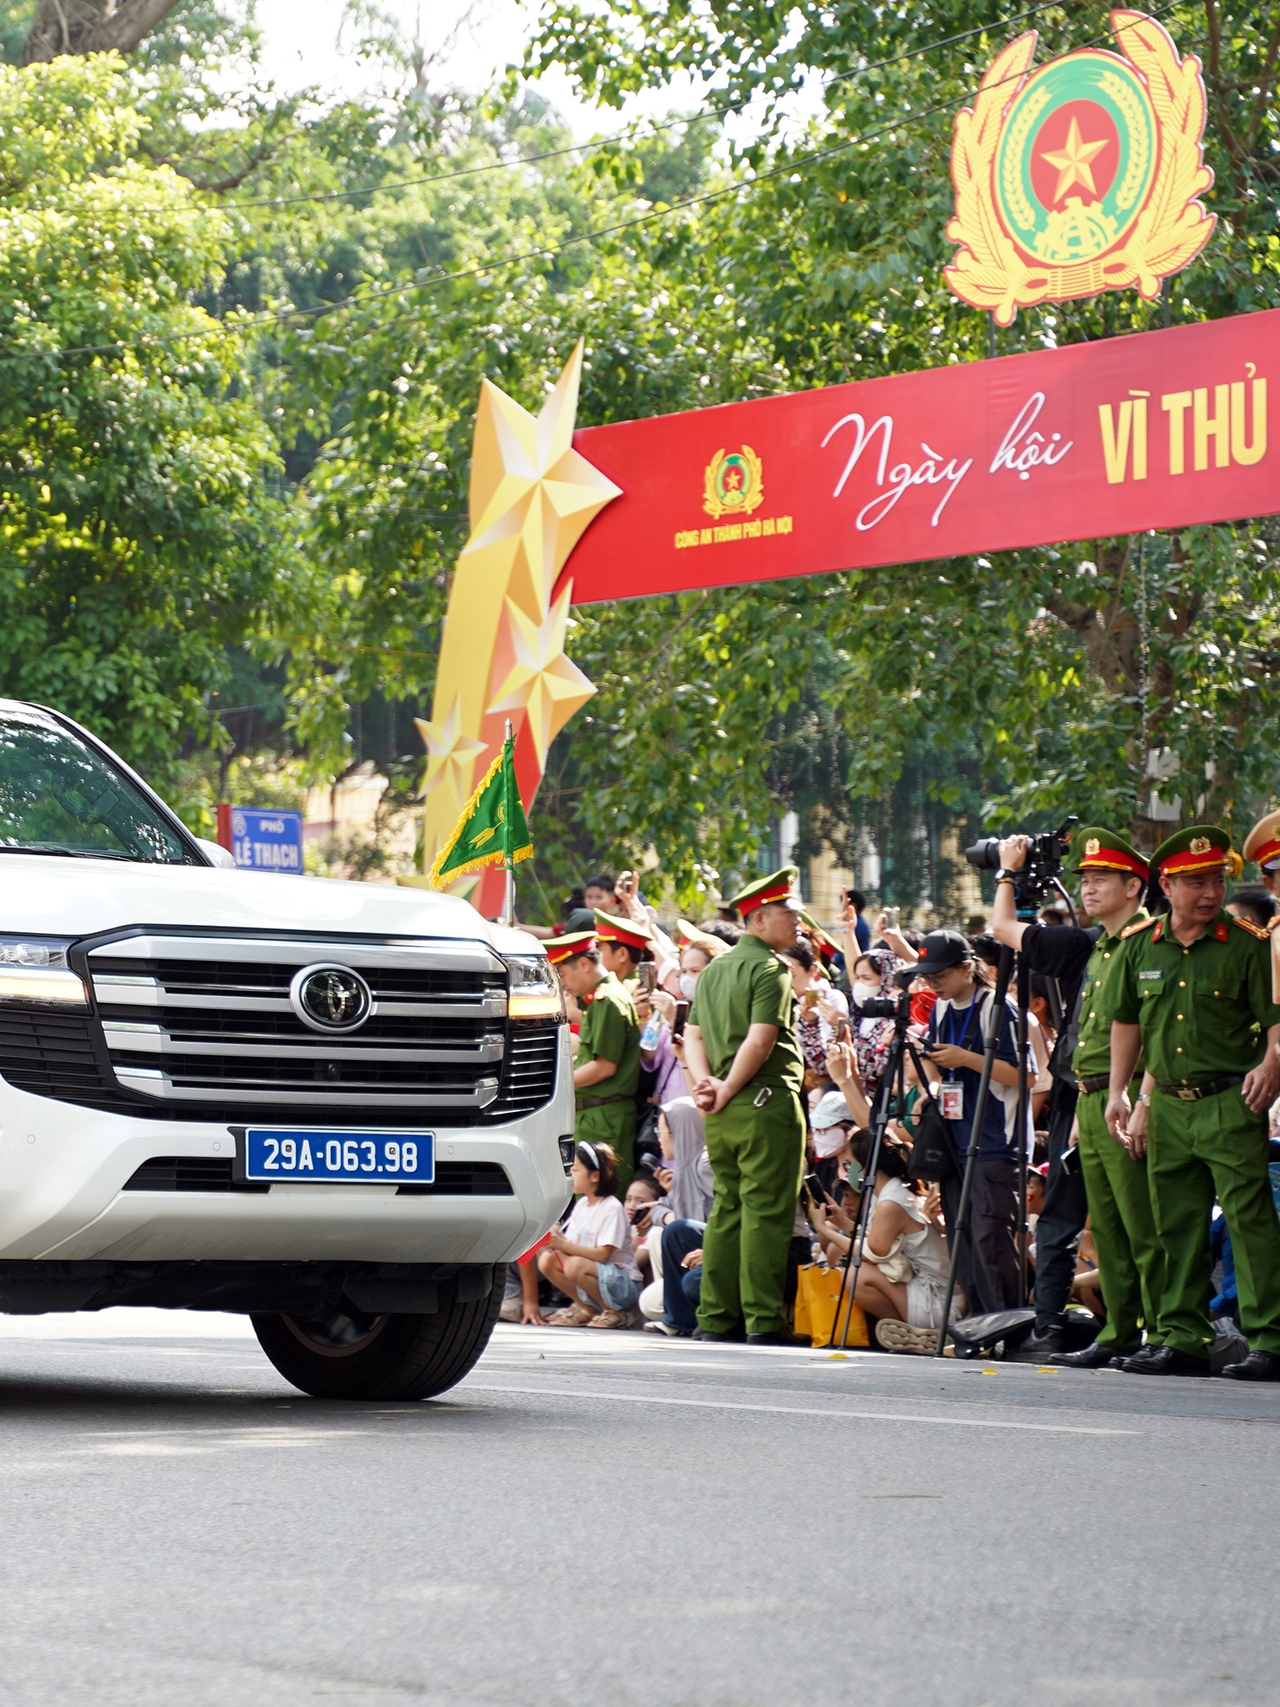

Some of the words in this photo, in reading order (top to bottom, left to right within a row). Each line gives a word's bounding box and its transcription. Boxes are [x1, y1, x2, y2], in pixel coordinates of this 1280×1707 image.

[1099, 390, 1150, 485] VÌ
[1161, 363, 1269, 475] THỦ
[820, 412, 974, 532] Ngày
[989, 391, 1074, 481] hội
[675, 530, 699, 549] CÔNG
[700, 528, 713, 545] AN
[713, 524, 743, 543] THÀNH
[743, 517, 761, 538] PHỐ
[762, 517, 776, 536] HÀ
[776, 515, 793, 535] NỘI
[260, 816, 285, 834] PHỐ
[234, 836, 252, 866] LÊ
[263, 1138, 418, 1173] 29A-063.98
